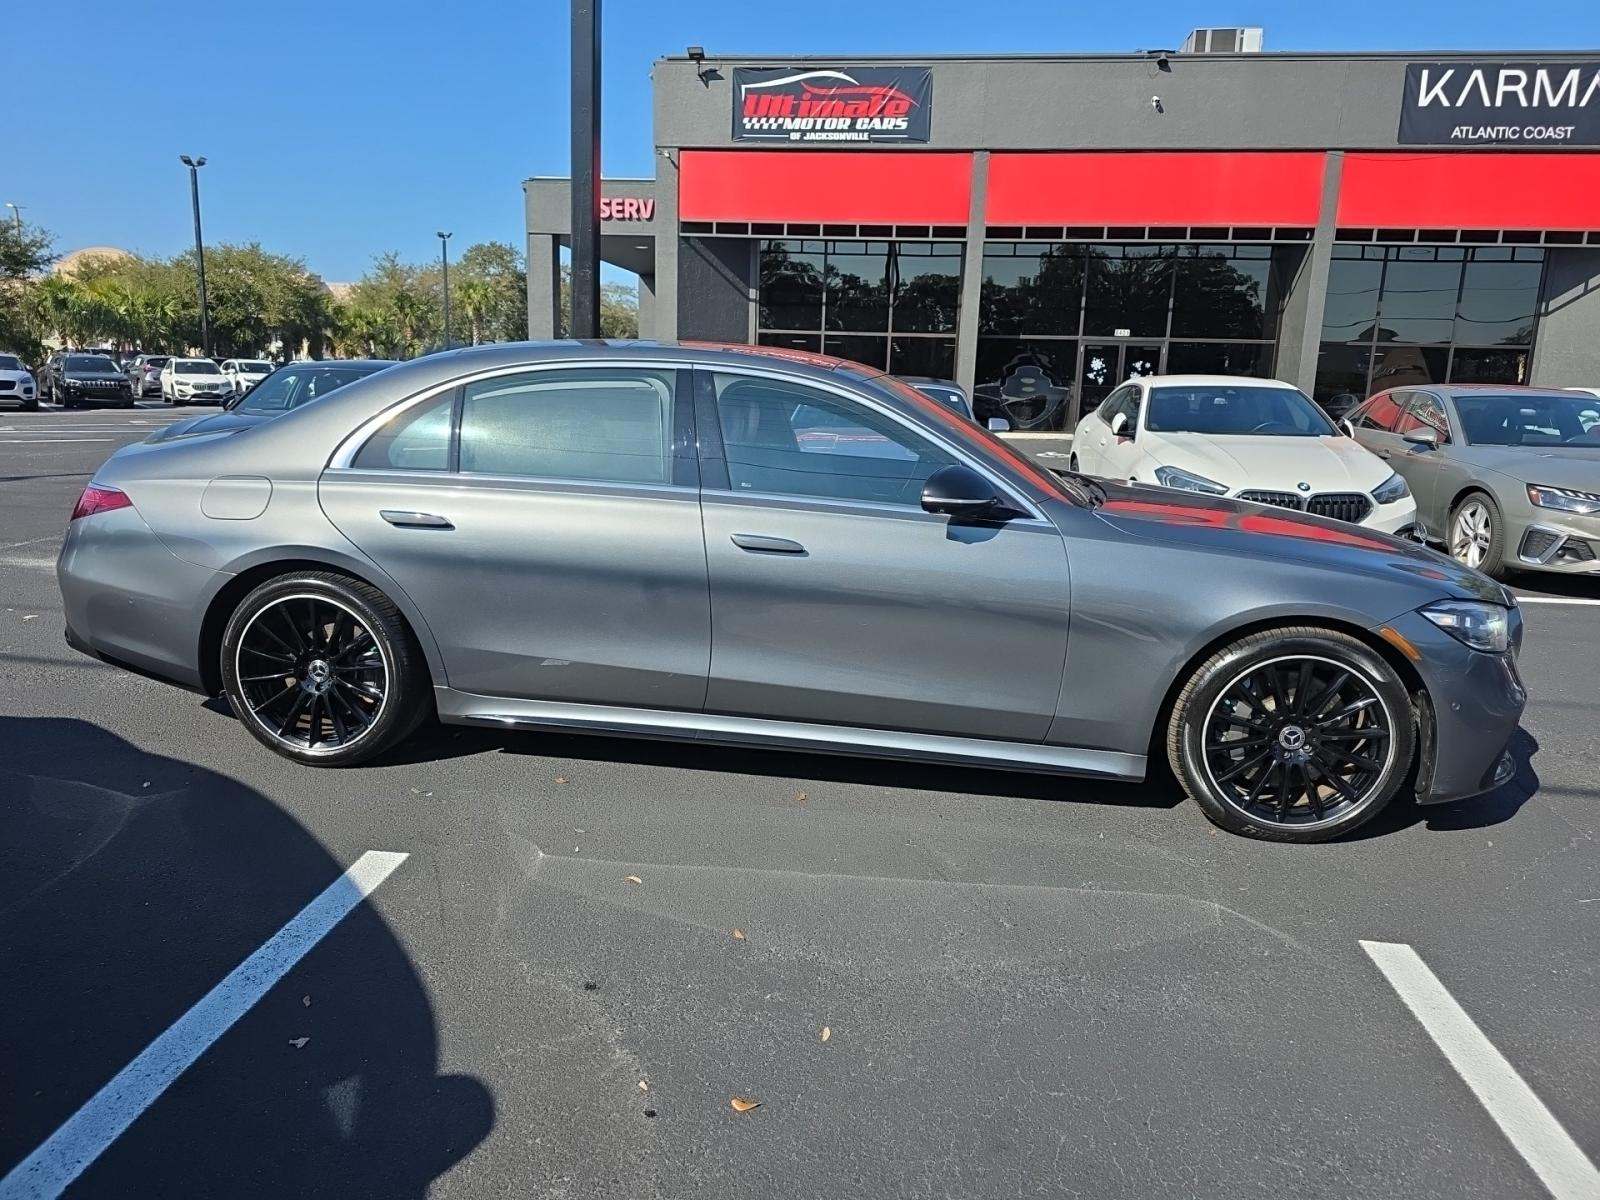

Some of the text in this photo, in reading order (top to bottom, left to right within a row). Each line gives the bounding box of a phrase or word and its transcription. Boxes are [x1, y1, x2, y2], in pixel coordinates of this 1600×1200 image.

[782, 117, 909, 130] MOTOR CARS
[789, 132, 869, 141] OF JACKSONVILLE
[1451, 126, 1576, 139] ATLANTIC COAST
[600, 198, 654, 219] SERV
